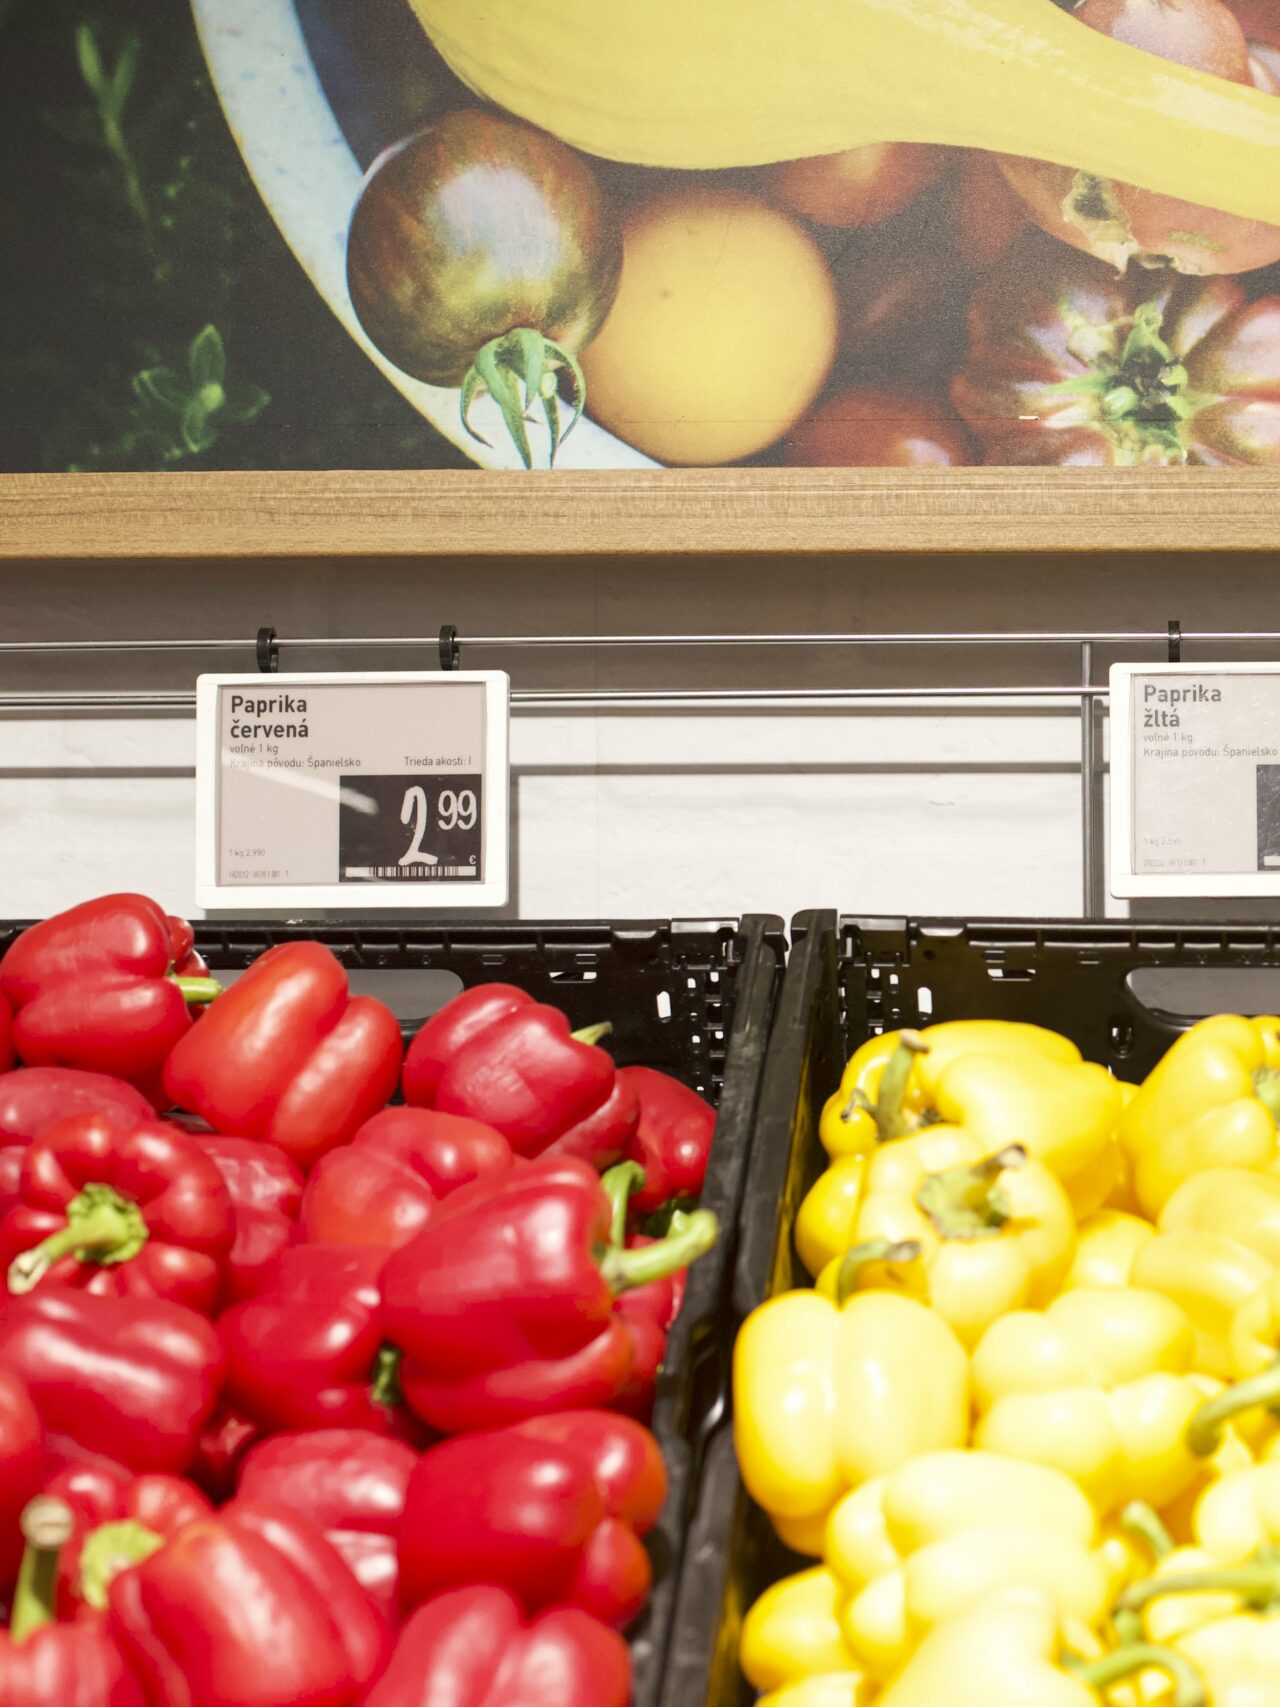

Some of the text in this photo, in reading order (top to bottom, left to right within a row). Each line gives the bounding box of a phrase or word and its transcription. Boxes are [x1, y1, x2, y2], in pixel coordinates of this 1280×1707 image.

[1143, 684, 1222, 707] Paprika
[231, 695, 307, 717] Paprika
[1143, 708, 1180, 728] žltá
[230, 718, 309, 738] červená
[1173, 733, 1177, 742] 1
[1181, 732, 1193, 744] kg
[259, 744, 263, 753] 1
[266, 743, 279, 755] kg
[1143, 748, 1179, 759] Krajina
[1223, 744, 1278, 759] Španielsko
[307, 755, 361, 769] Španielsko
[404, 756, 433, 766] Trieda
[398, 785, 478, 866] 2 99
